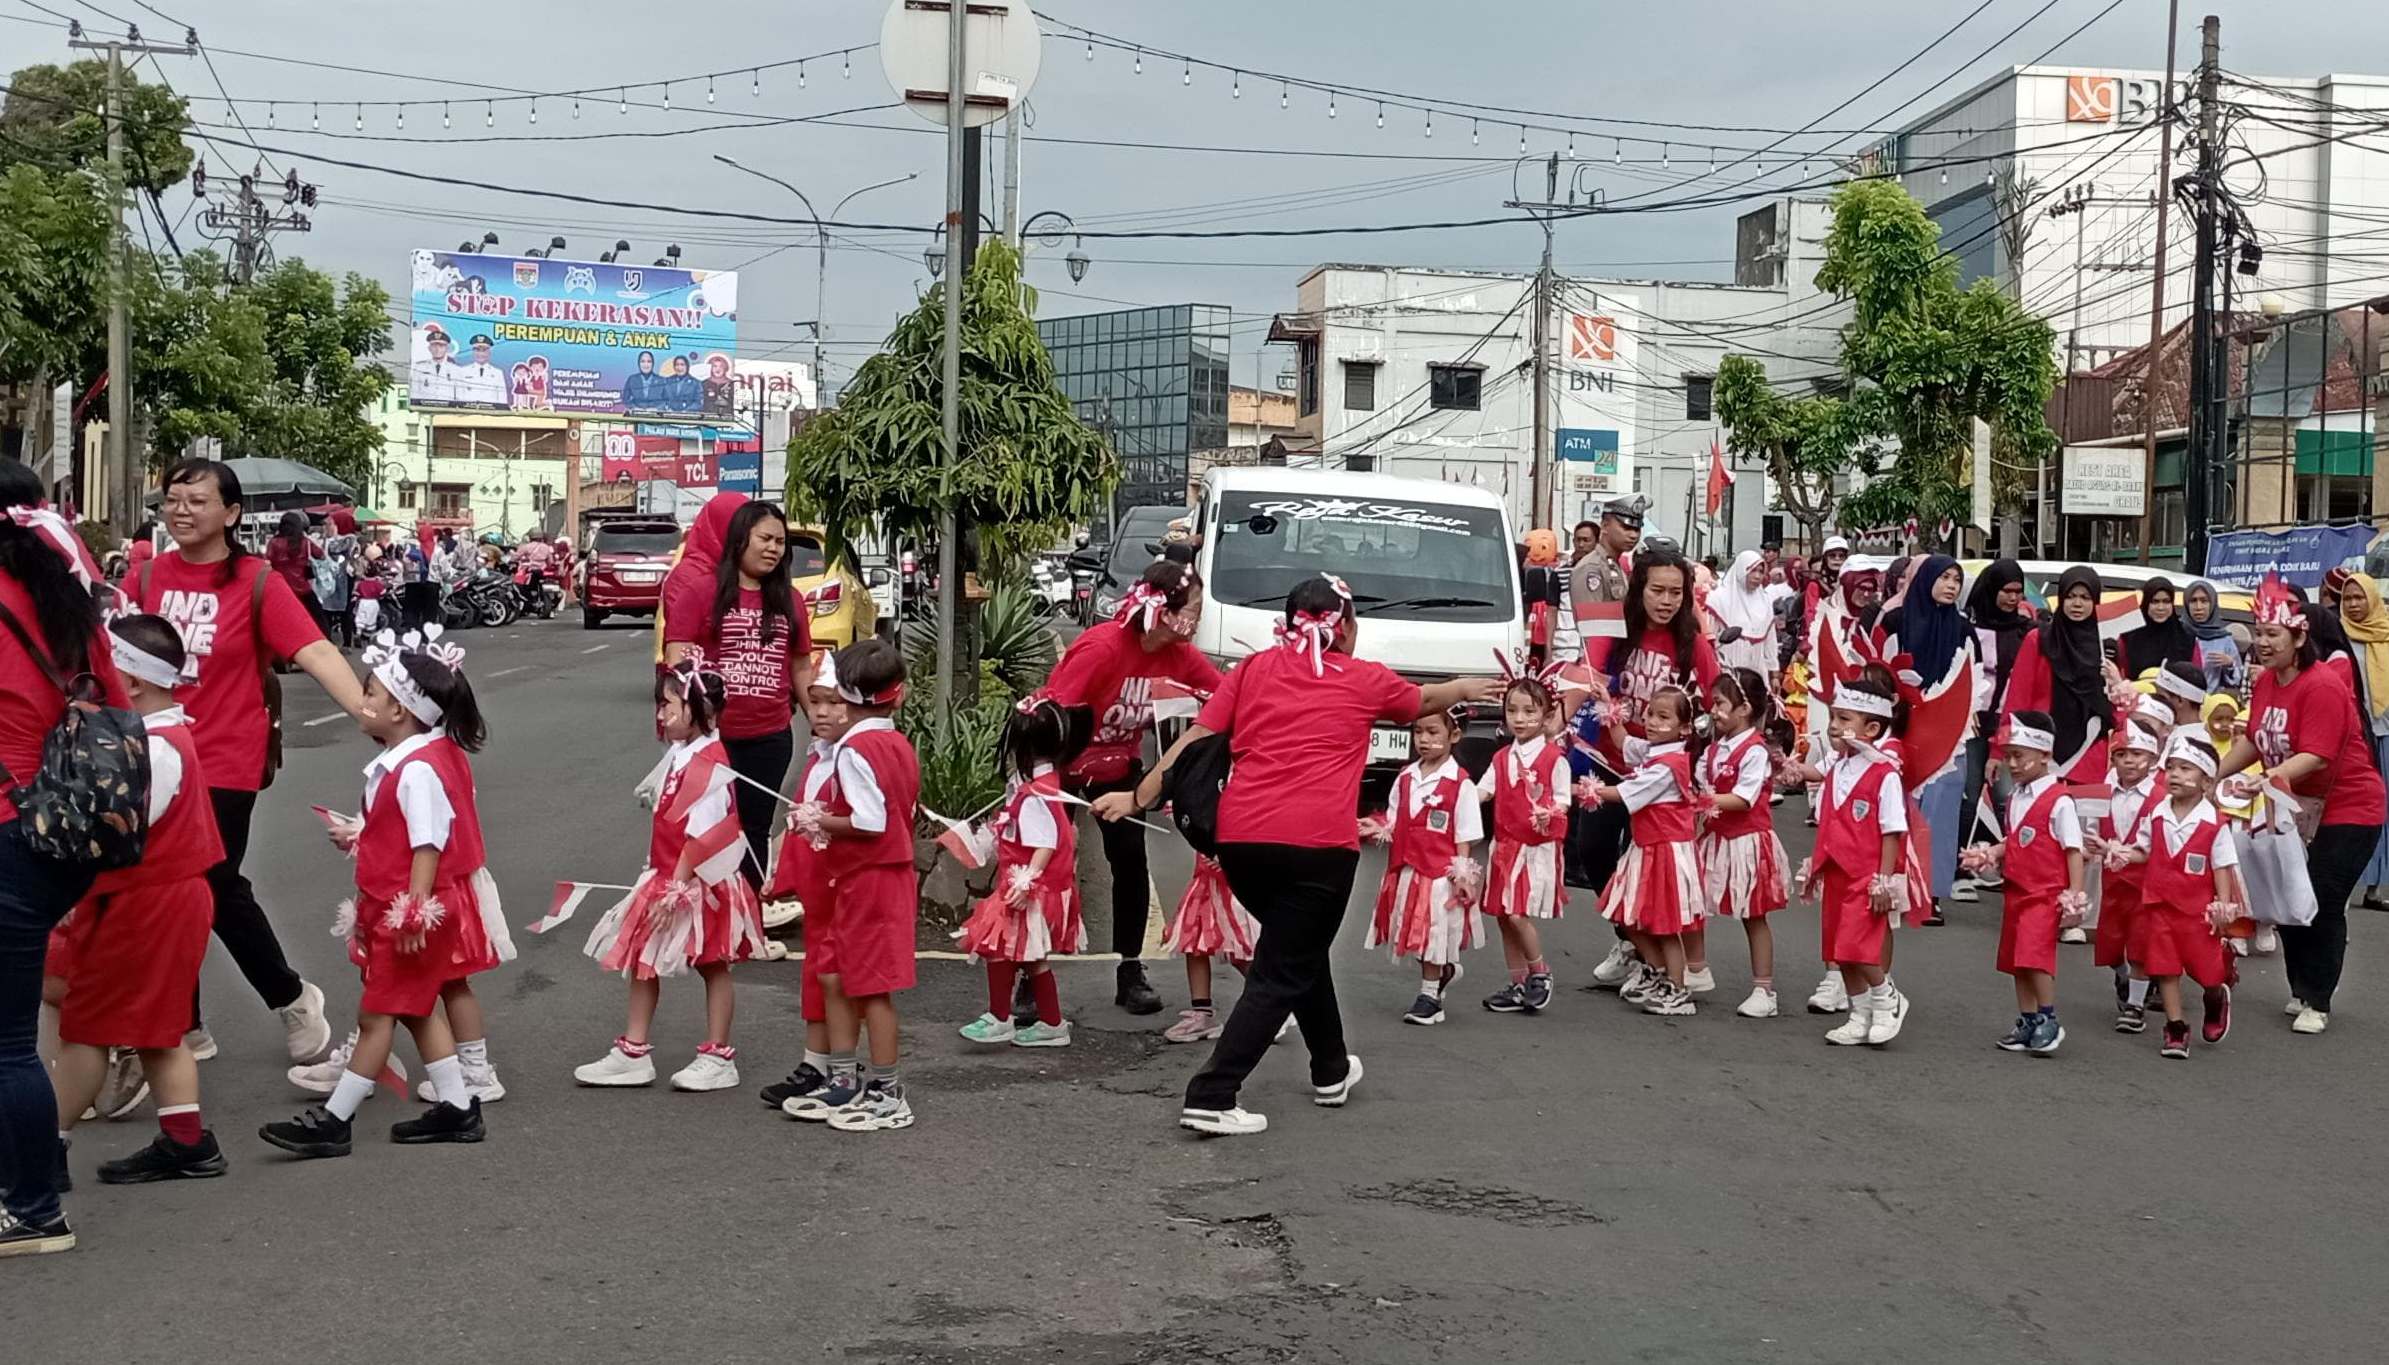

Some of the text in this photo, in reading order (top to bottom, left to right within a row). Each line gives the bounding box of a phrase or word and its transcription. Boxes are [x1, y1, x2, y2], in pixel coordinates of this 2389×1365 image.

[446, 293, 703, 329] STOP KEKERASAN!!
[494, 322, 671, 350] PEREMPUAN & ANAK
[1569, 370, 1614, 393] BNI
[1564, 437, 1592, 449] ATM
[684, 462, 710, 482] TCL
[718, 466, 759, 481] Panasonic
[1388, 732, 1408, 749] HW
